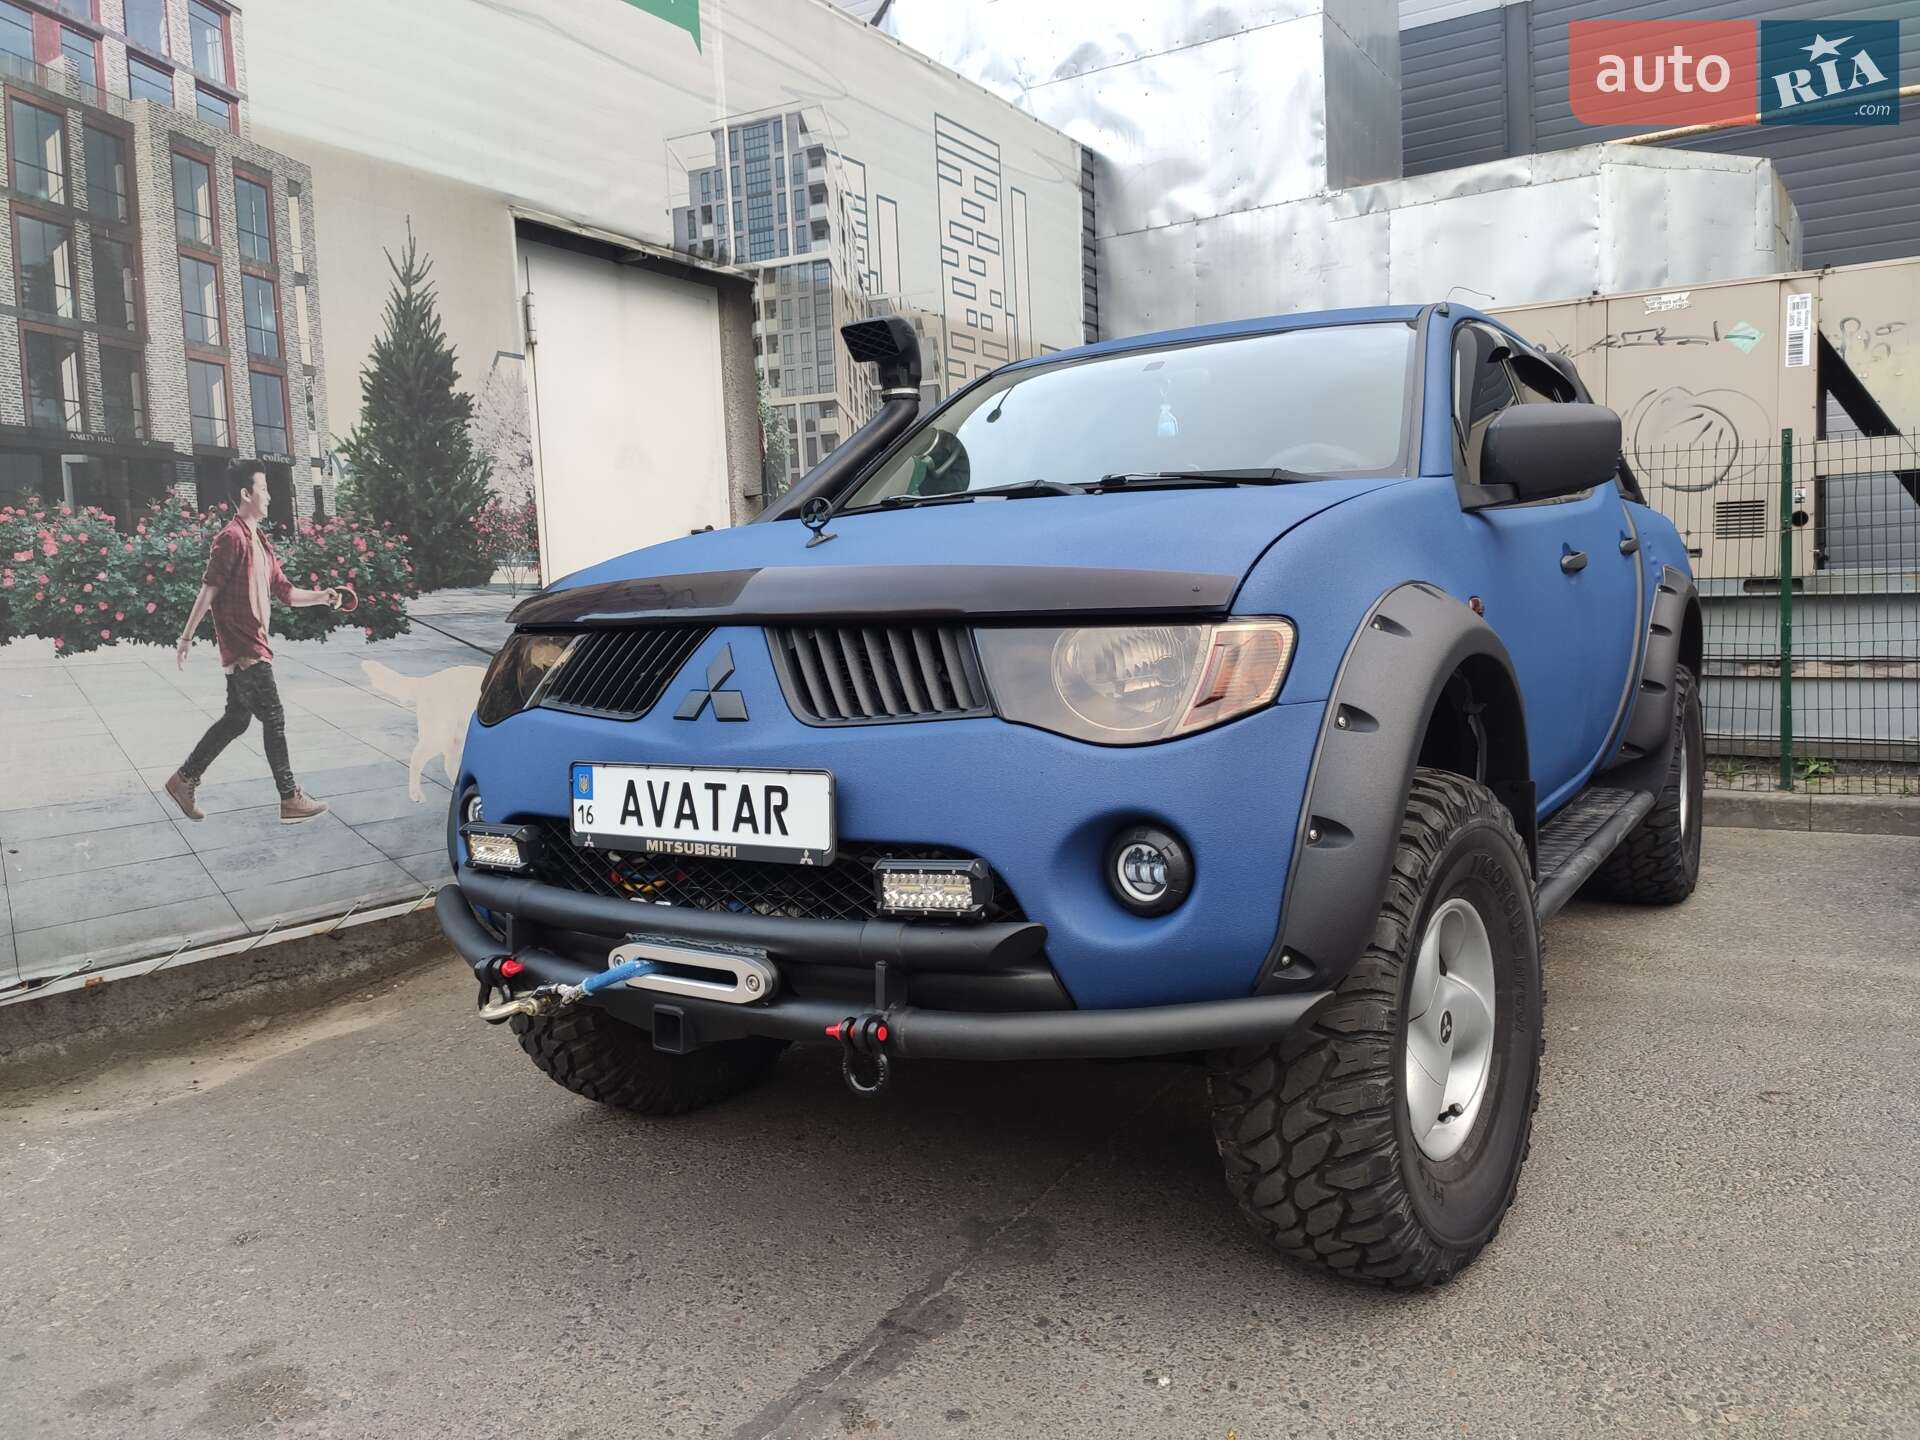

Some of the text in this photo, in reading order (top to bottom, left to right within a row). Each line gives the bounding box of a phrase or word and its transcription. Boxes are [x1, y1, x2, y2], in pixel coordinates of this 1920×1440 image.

[577, 804, 594, 825] 16
[619, 779, 789, 836] AVATAR
[646, 839, 737, 858] MITSUBISHI
